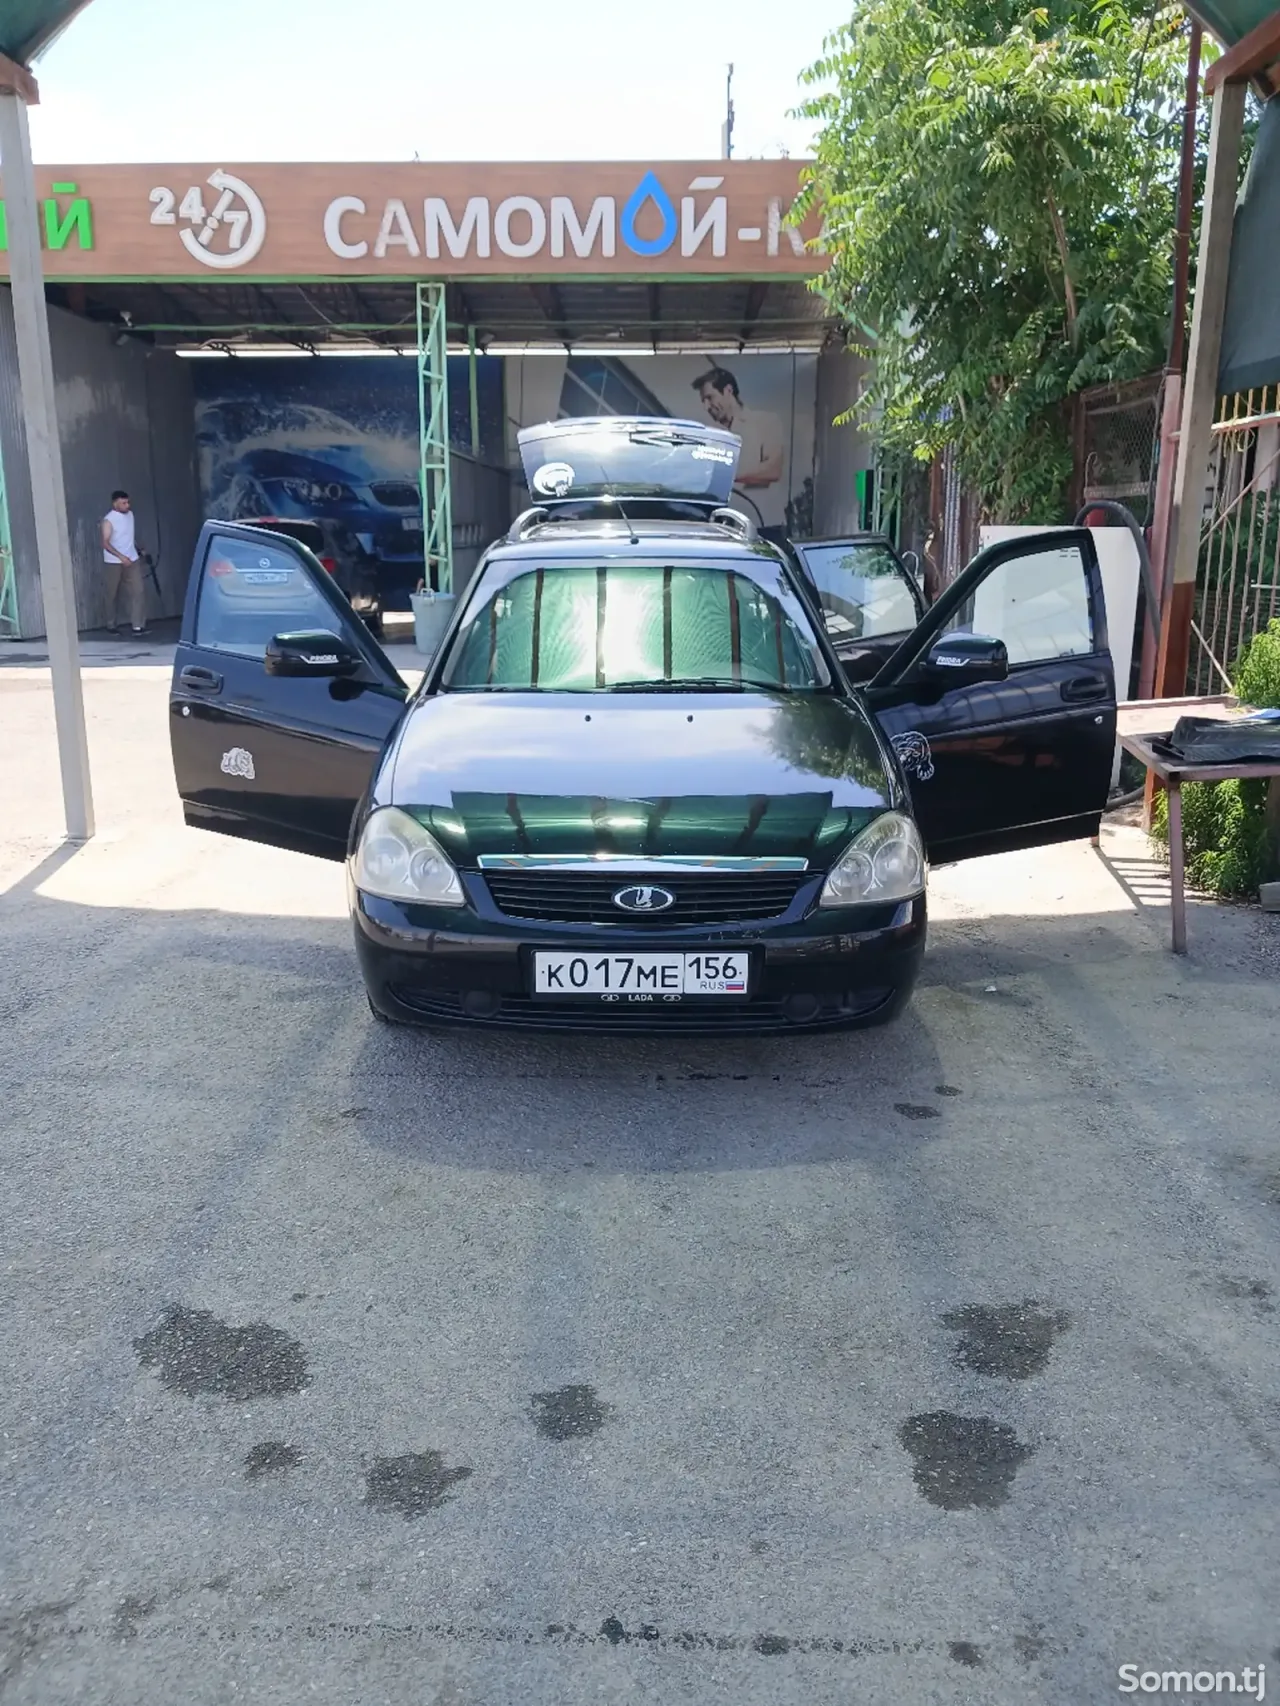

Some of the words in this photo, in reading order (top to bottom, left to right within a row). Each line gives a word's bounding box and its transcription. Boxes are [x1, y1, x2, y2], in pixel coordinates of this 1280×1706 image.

[688, 956, 737, 980] 156
[700, 980, 725, 991] RUS
[628, 993, 654, 1002] LADA
